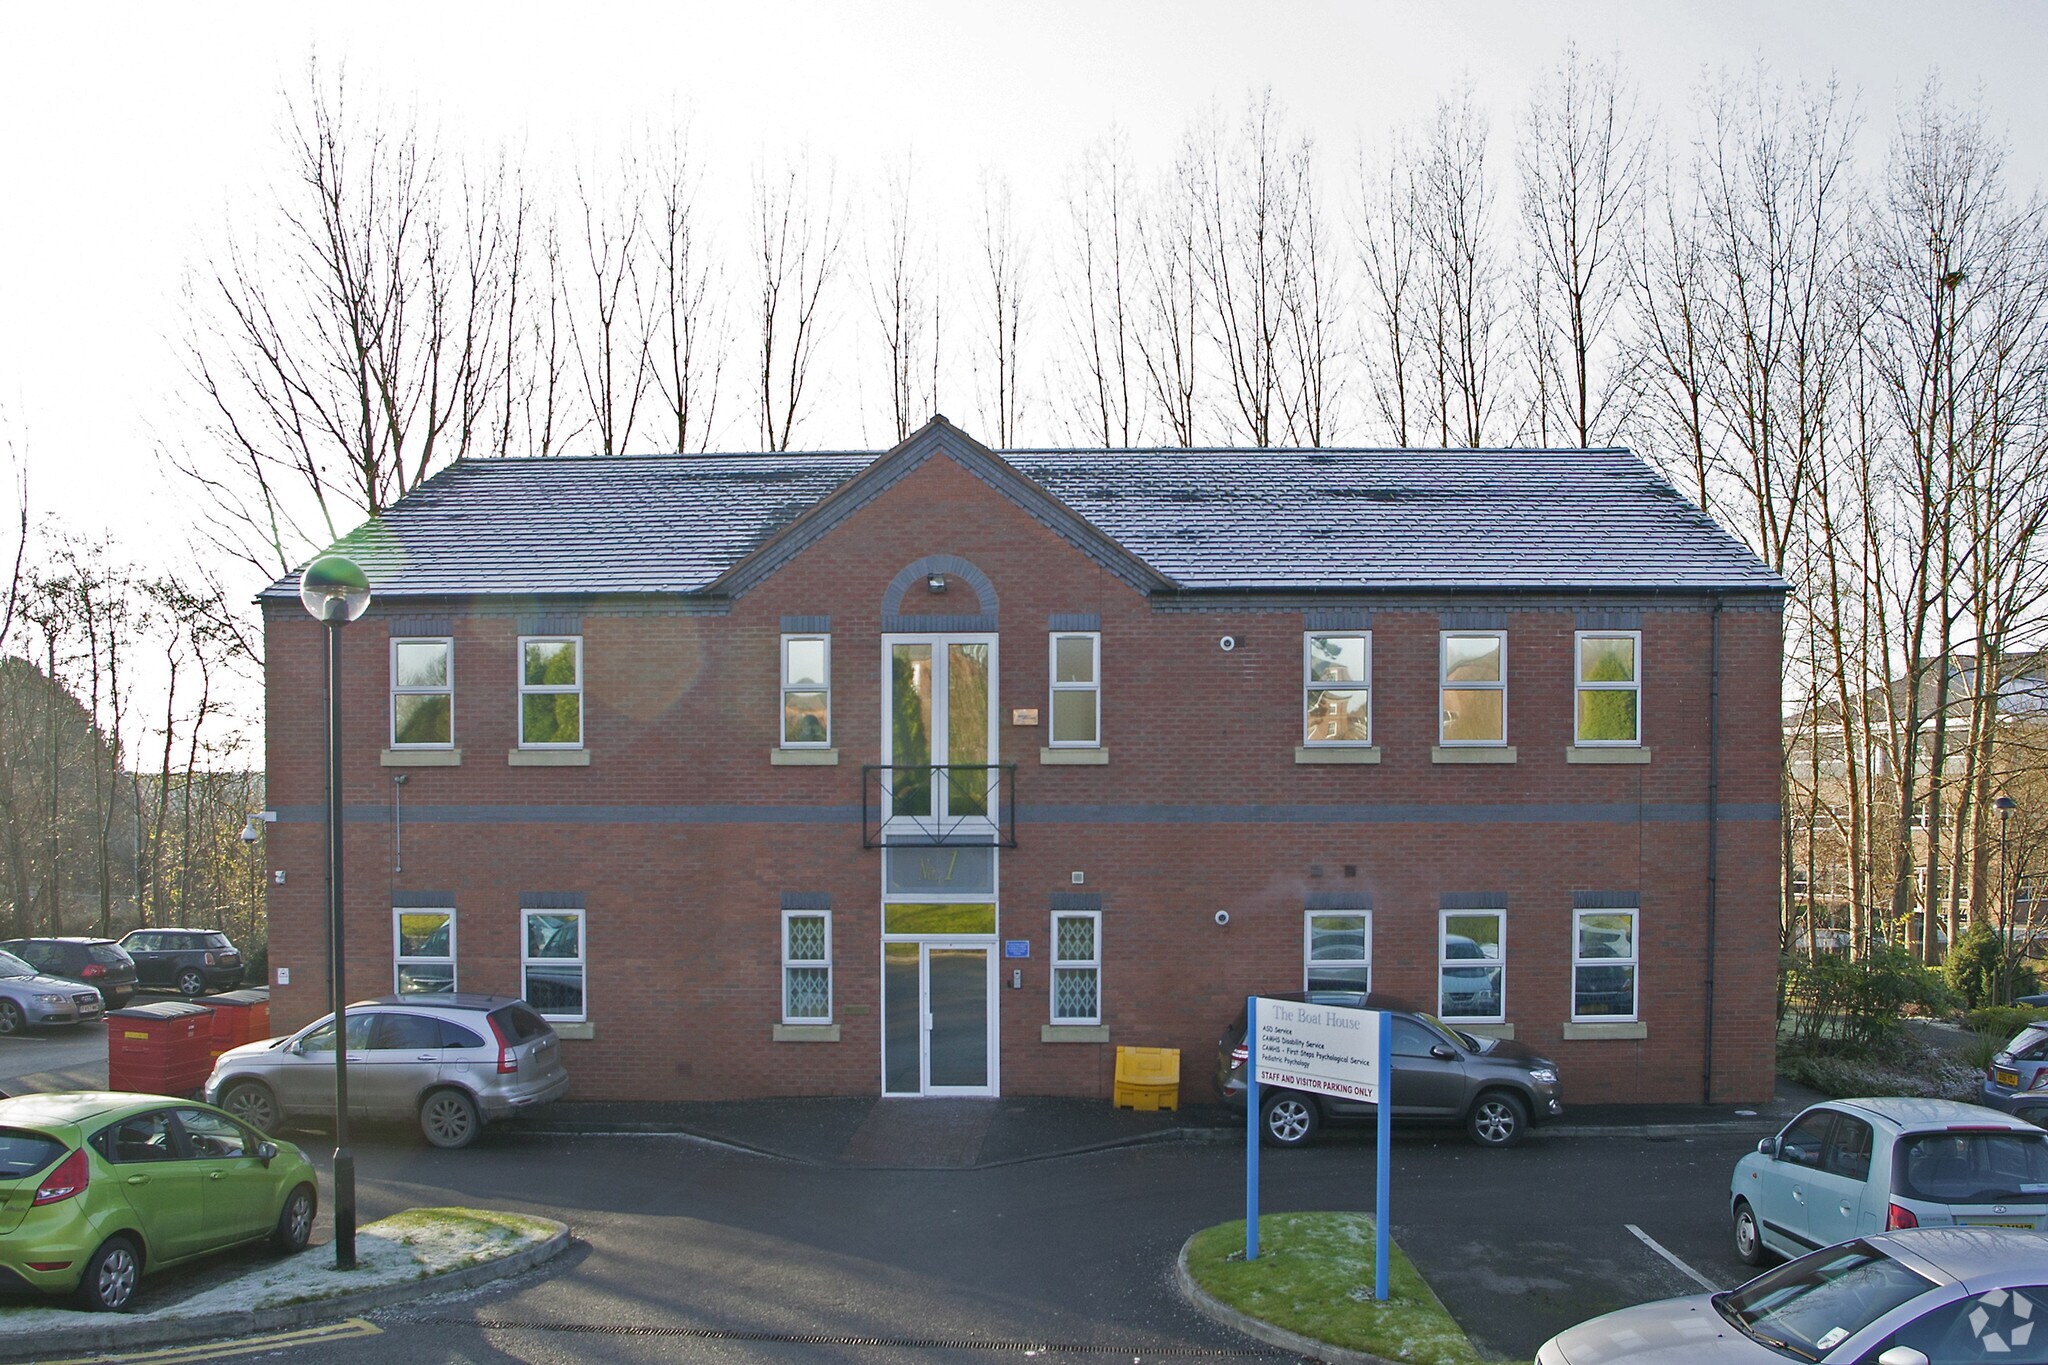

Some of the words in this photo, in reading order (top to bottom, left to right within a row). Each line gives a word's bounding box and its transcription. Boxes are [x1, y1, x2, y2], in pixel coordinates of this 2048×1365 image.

[1272, 1004, 1294, 1021] The
[1298, 1008, 1321, 1025] Boat
[1326, 1011, 1361, 1030] House
[1274, 1026, 1292, 1035] Service
[1262, 1035, 1281, 1043] CAMHS
[1282, 1037, 1304, 1048] Disability
[1306, 1040, 1325, 1050] Service
[1262, 1044, 1281, 1053] CAMHS
[1286, 1047, 1299, 1056] First
[1300, 1049, 1315, 1059] Steps
[1316, 1051, 1349, 1064] Psychological
[1350, 1056, 1370, 1066] Service
[1284, 1056, 1310, 1069] Psychology
[1261, 1071, 1280, 1080] STAFF
[1281, 1074, 1295, 1084] AND
[1296, 1077, 1322, 1089] VISITOR
[1323, 1081, 1353, 1094] PARKING
[1354, 1086, 1373, 1098] ONLY
